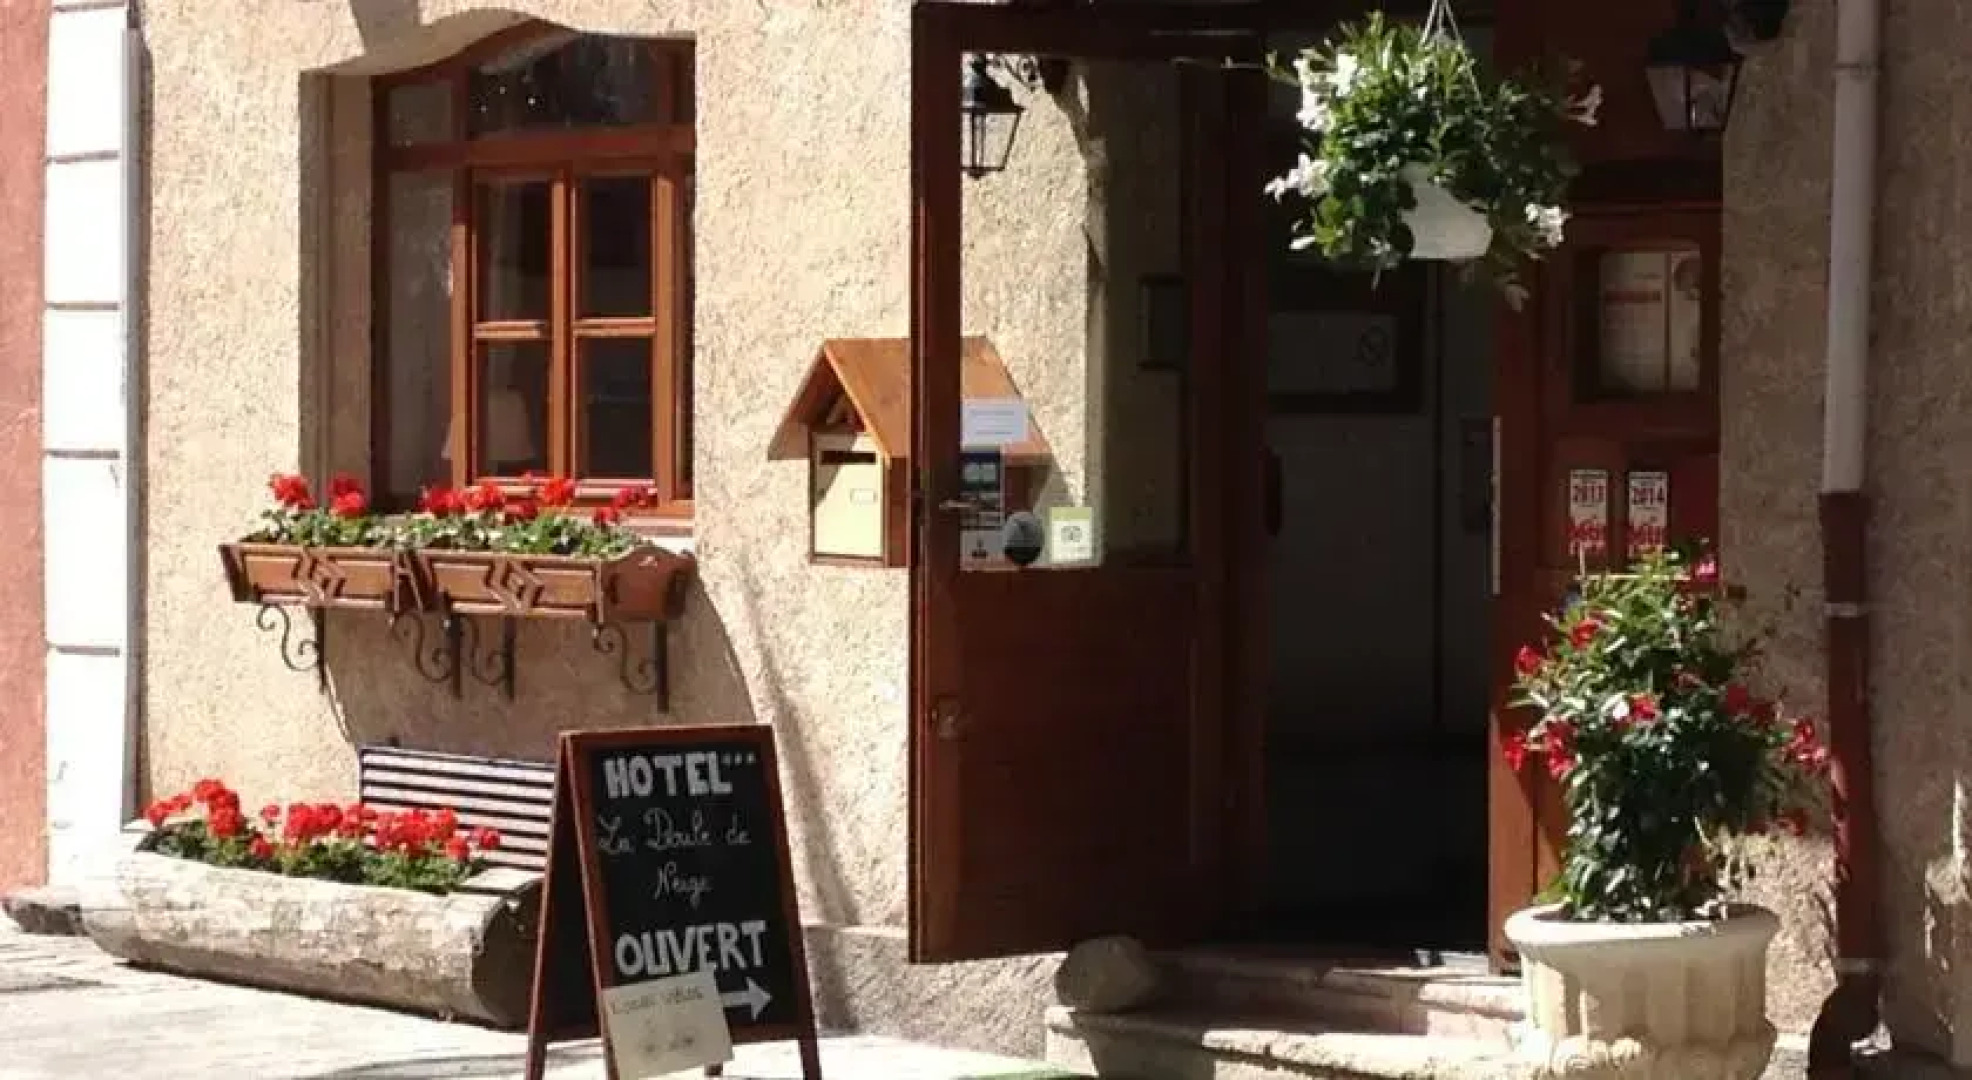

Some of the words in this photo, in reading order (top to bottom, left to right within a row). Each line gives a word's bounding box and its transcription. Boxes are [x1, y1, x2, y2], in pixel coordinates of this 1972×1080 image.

[603, 750, 733, 799] HOTEL
[598, 814, 635, 855] La
[725, 810, 752, 846] de
[614, 919, 767, 976] OUVERT
